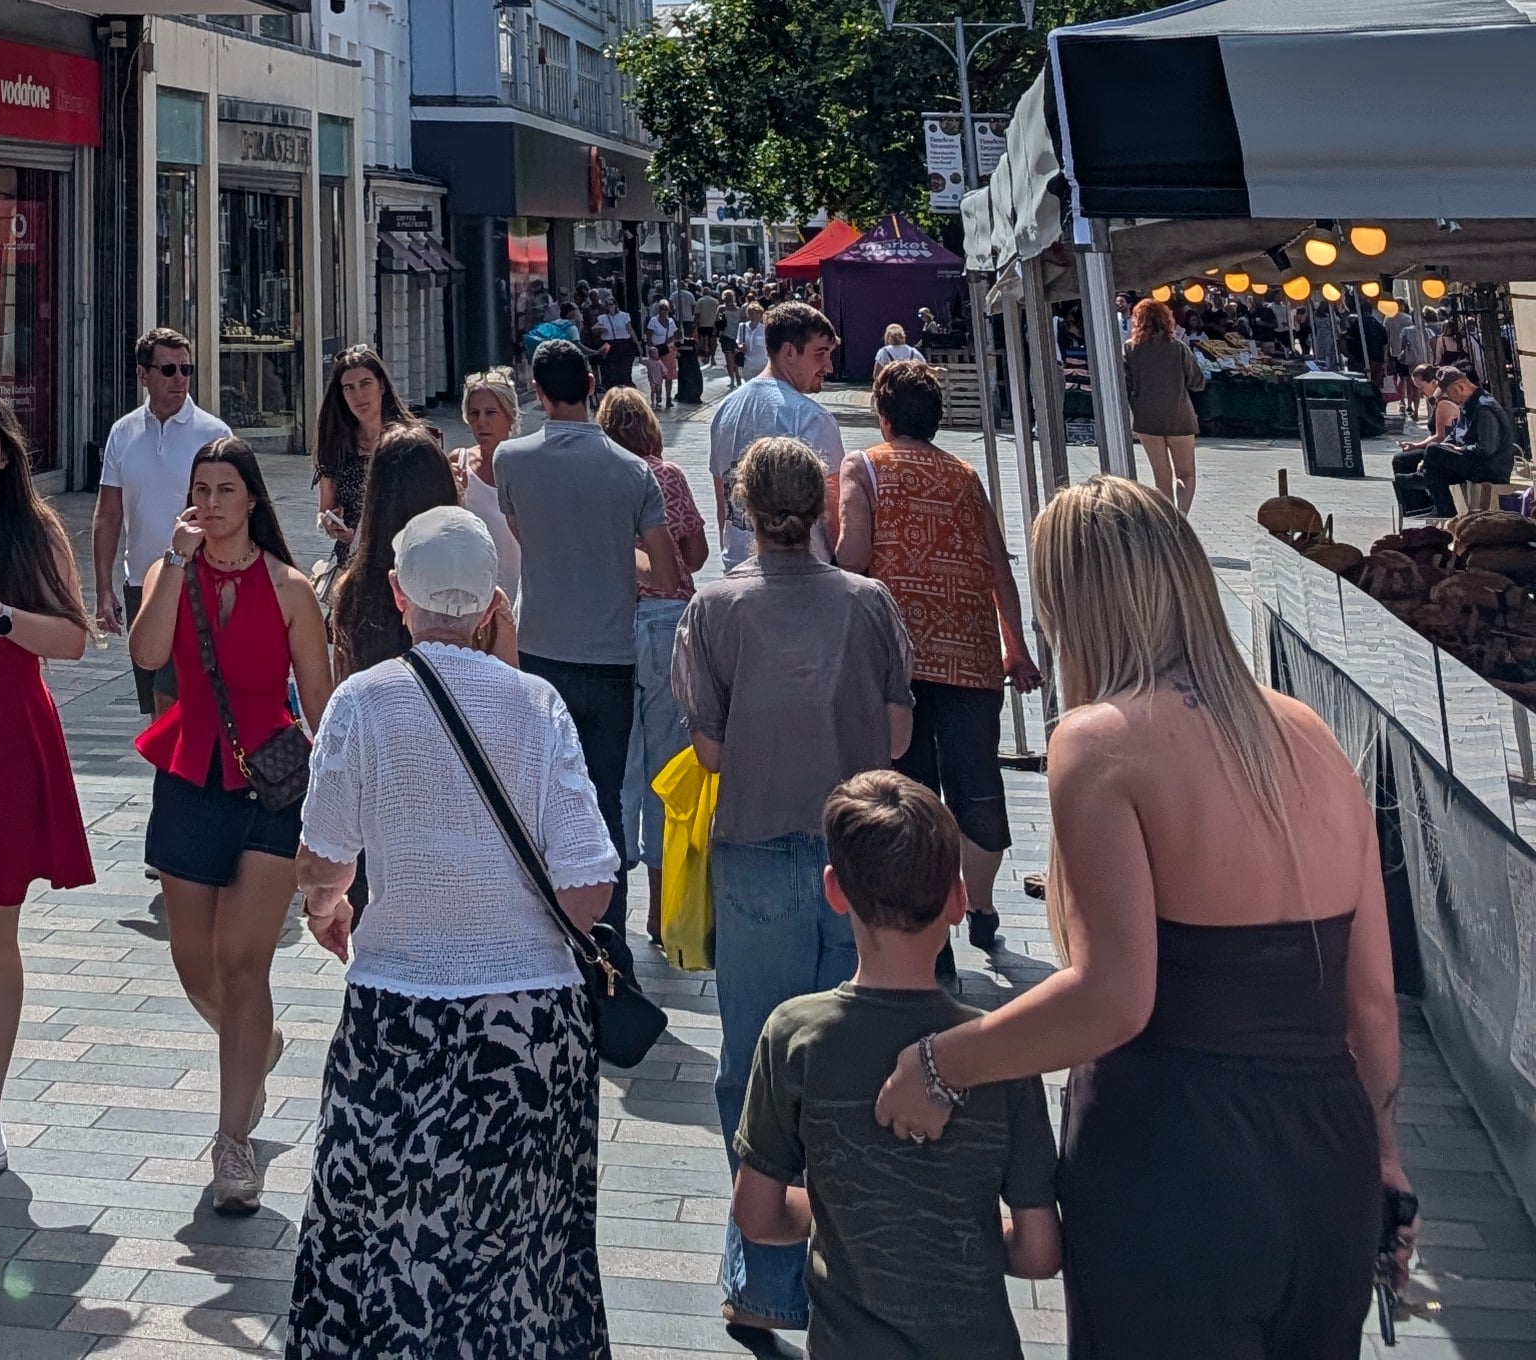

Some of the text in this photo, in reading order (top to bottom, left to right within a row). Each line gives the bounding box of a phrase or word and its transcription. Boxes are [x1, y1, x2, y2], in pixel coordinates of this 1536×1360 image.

[1, 74, 50, 109] vodafone
[866, 239, 928, 251] market
[1339, 409, 1354, 468] Chelmsford
